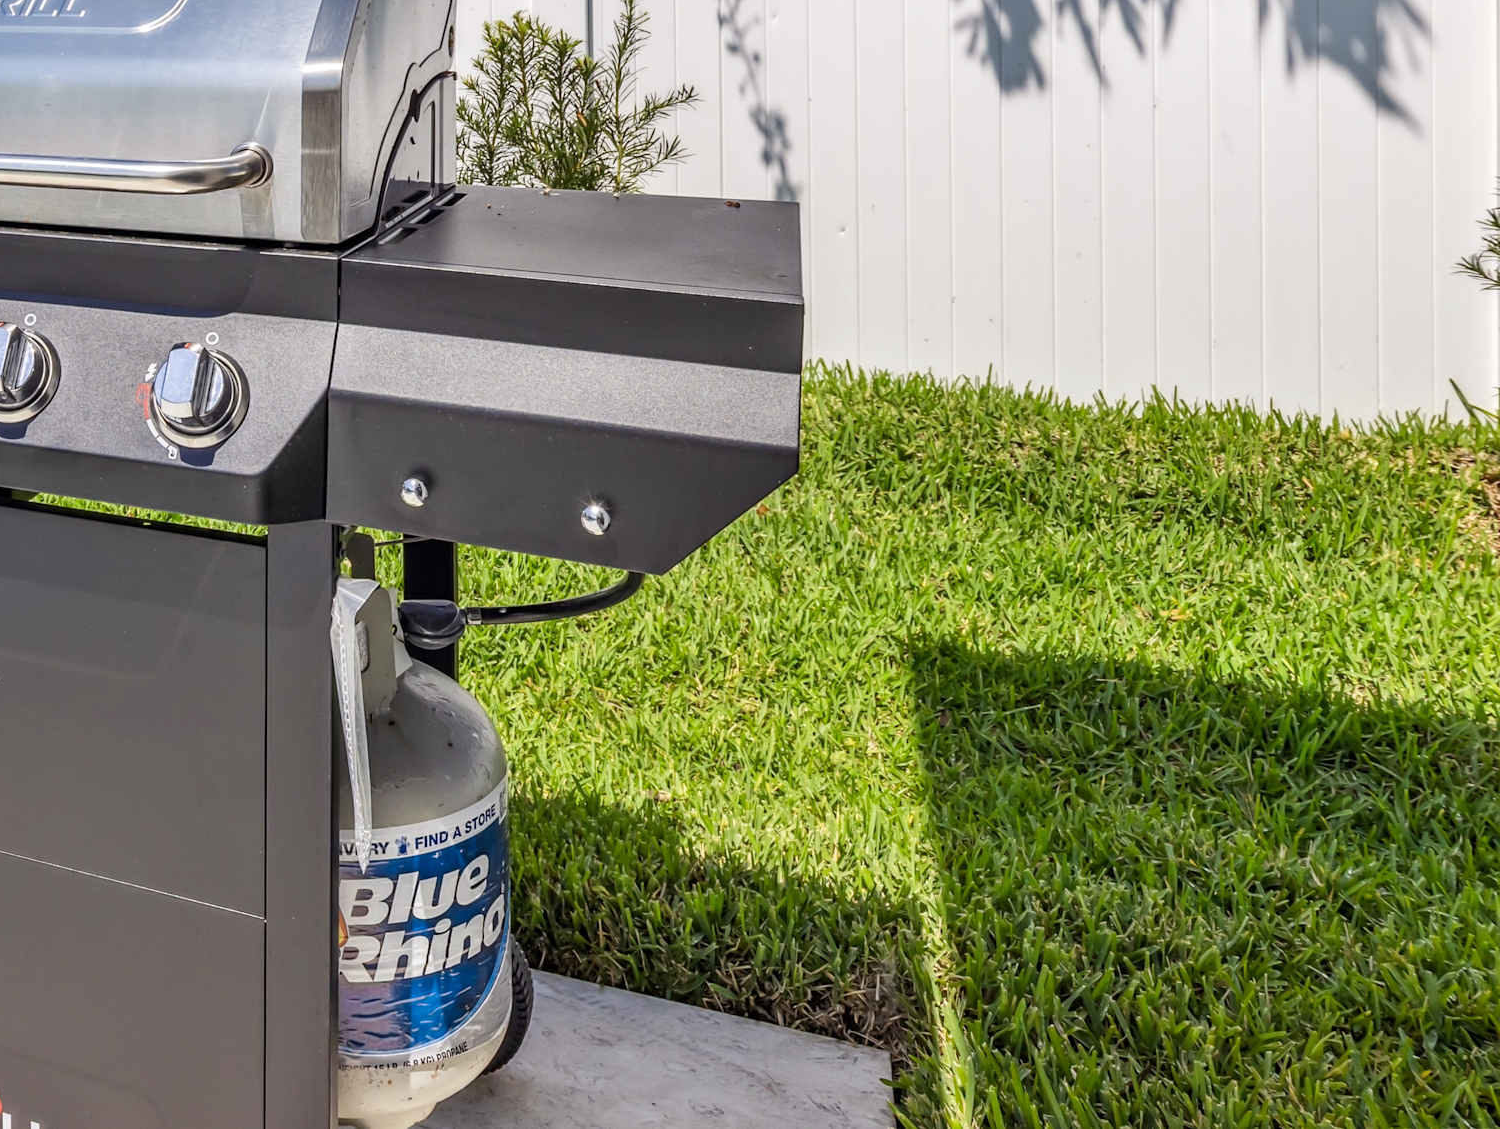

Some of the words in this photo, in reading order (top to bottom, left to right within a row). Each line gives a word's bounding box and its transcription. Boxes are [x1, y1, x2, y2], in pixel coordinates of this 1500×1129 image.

[415, 830, 449, 850] FIND
[453, 826, 462, 840] A
[465, 803, 497, 834] STORE
[338, 854, 490, 926] Blue
[338, 894, 505, 983] Rhino
